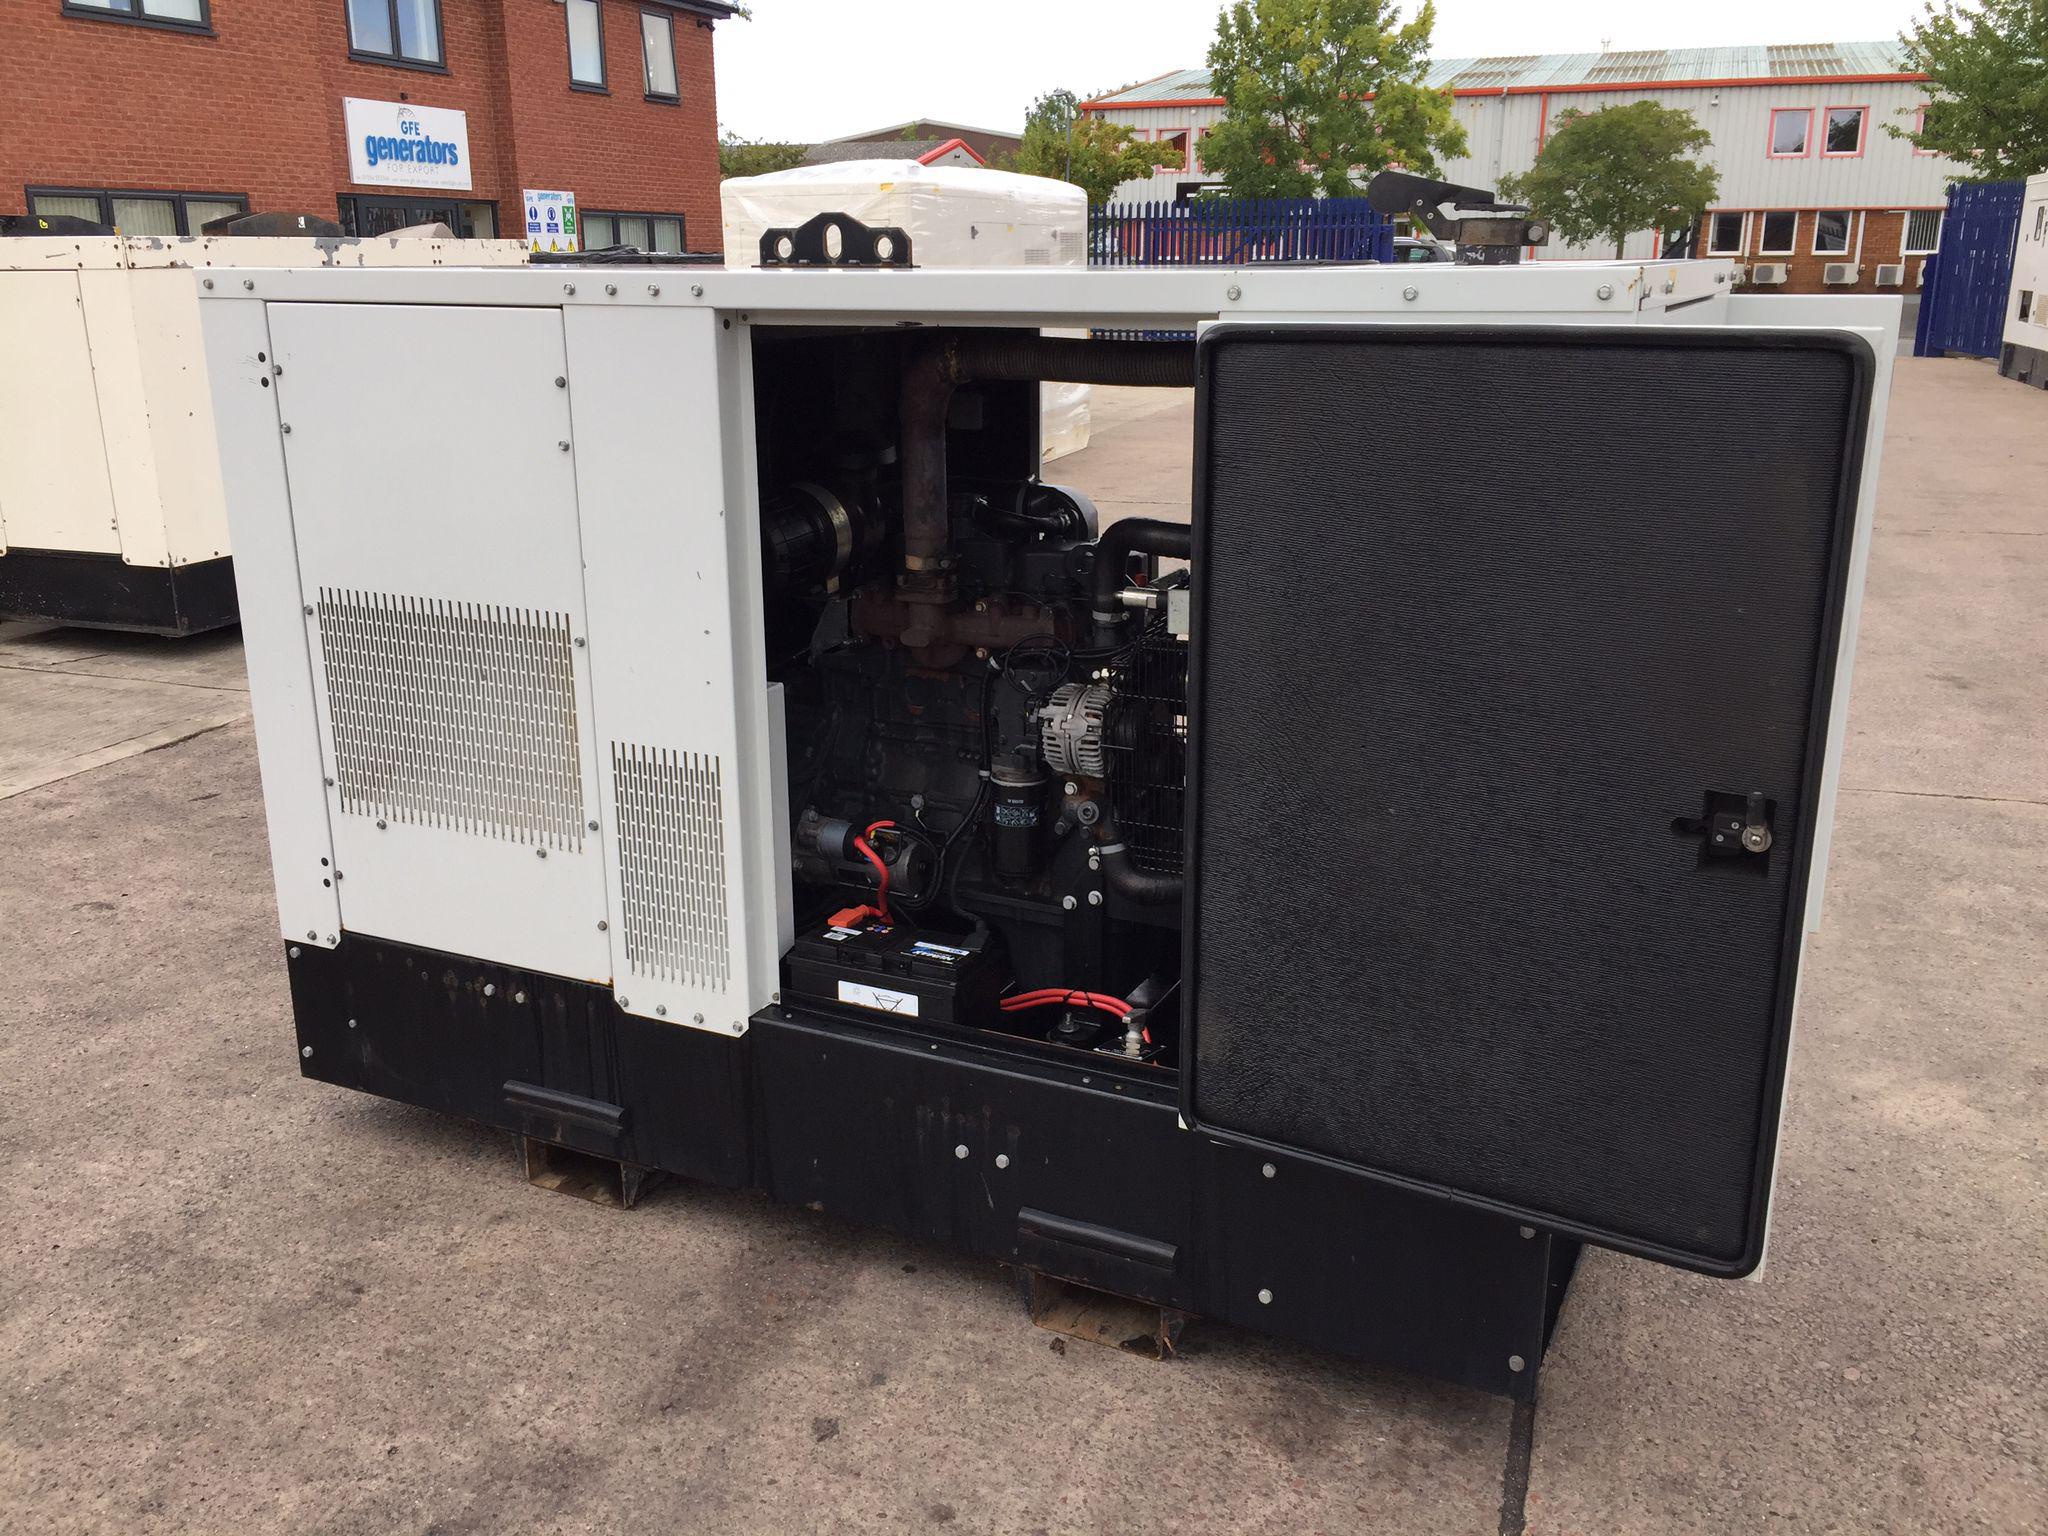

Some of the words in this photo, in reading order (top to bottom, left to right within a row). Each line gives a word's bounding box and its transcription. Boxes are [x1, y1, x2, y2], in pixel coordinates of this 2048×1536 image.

[400, 120, 421, 136] GFE
[365, 135, 459, 166] generators
[387, 163, 403, 173] FOR
[407, 164, 440, 176] EXPORT
[537, 192, 562, 202] generators
